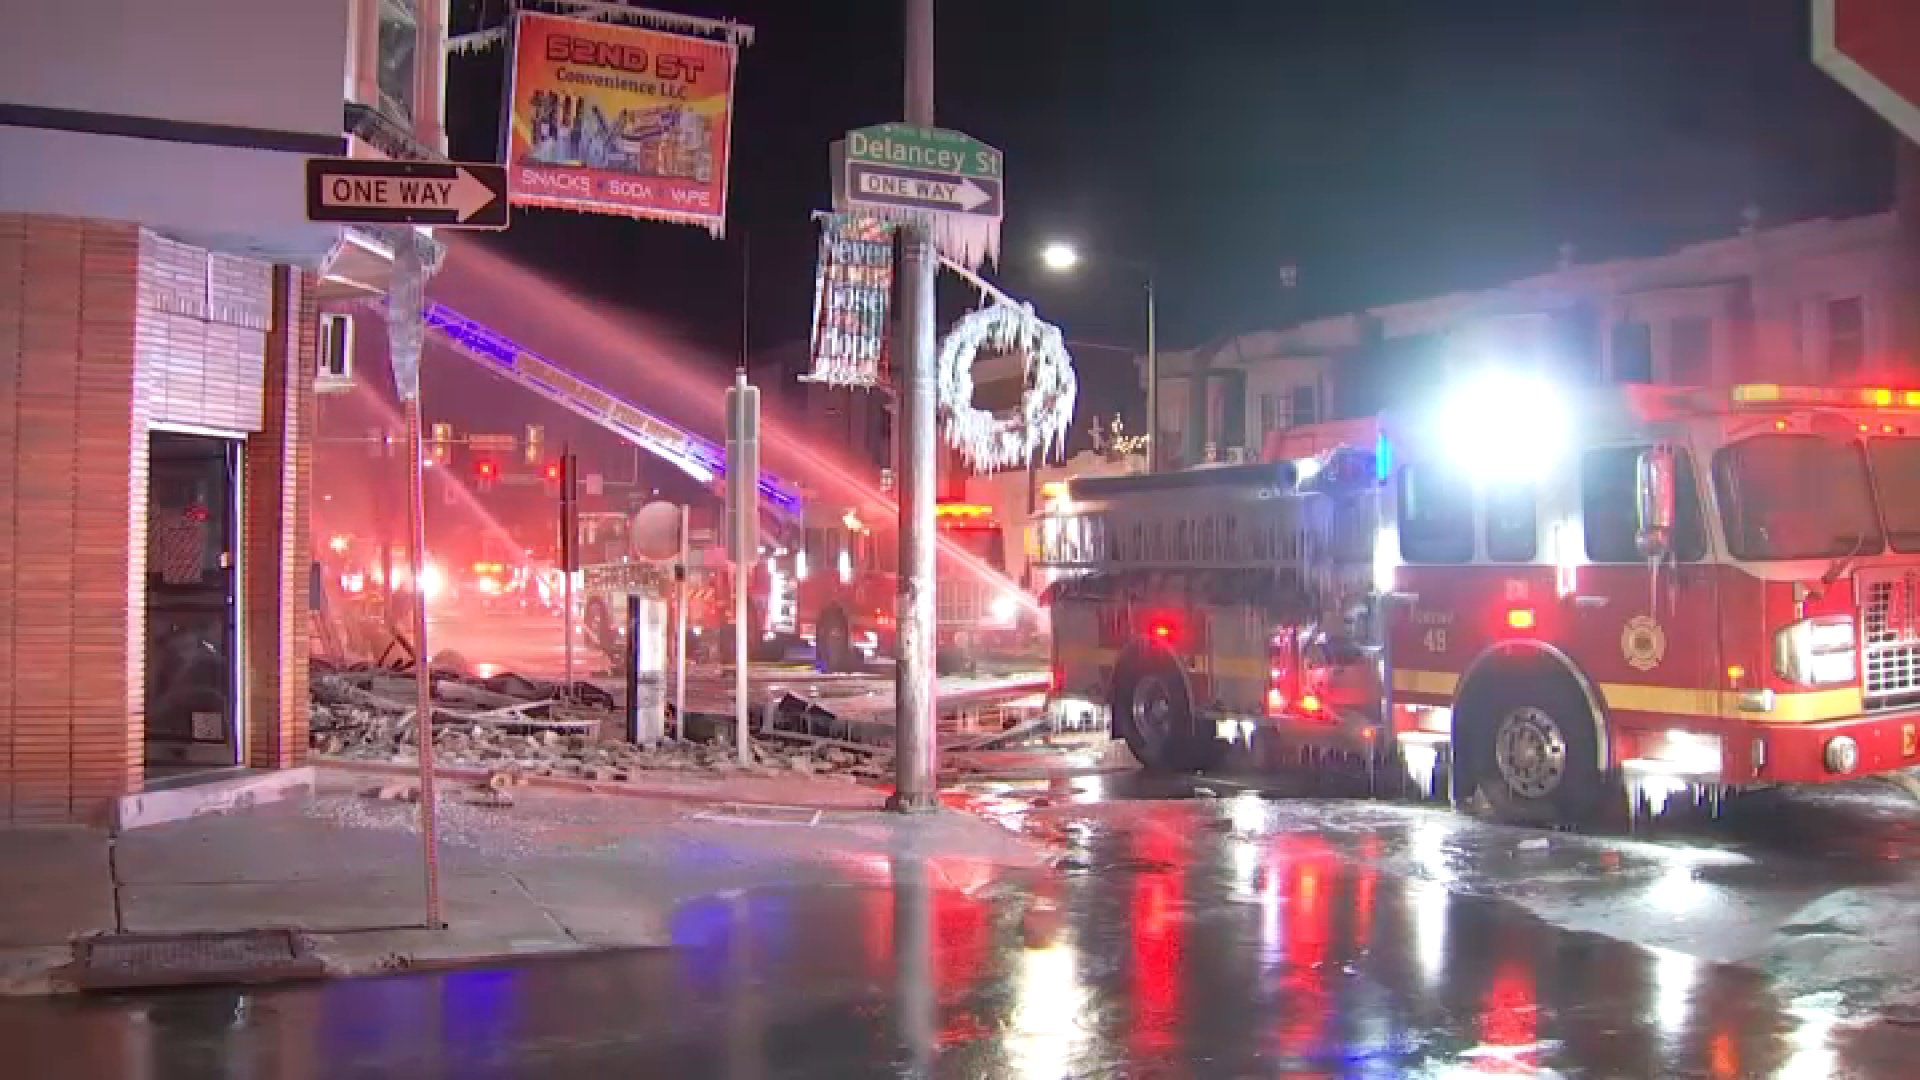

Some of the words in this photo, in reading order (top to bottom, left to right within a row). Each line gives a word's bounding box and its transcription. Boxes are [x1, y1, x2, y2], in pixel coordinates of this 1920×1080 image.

[546, 33, 649, 72] 52ND
[655, 54, 705, 84] ST
[556, 66, 656, 95] Convenience
[660, 82, 689, 100] LLC
[851, 133, 965, 174] Delancey
[975, 151, 998, 174] St
[332, 177, 388, 203] ONE
[399, 181, 452, 205] WAY
[521, 169, 590, 194] SNACKS
[607, 179, 652, 198] SODA
[671, 187, 710, 206] VAPE
[868, 175, 908, 195] ONE
[916, 182, 957, 200] WAY
